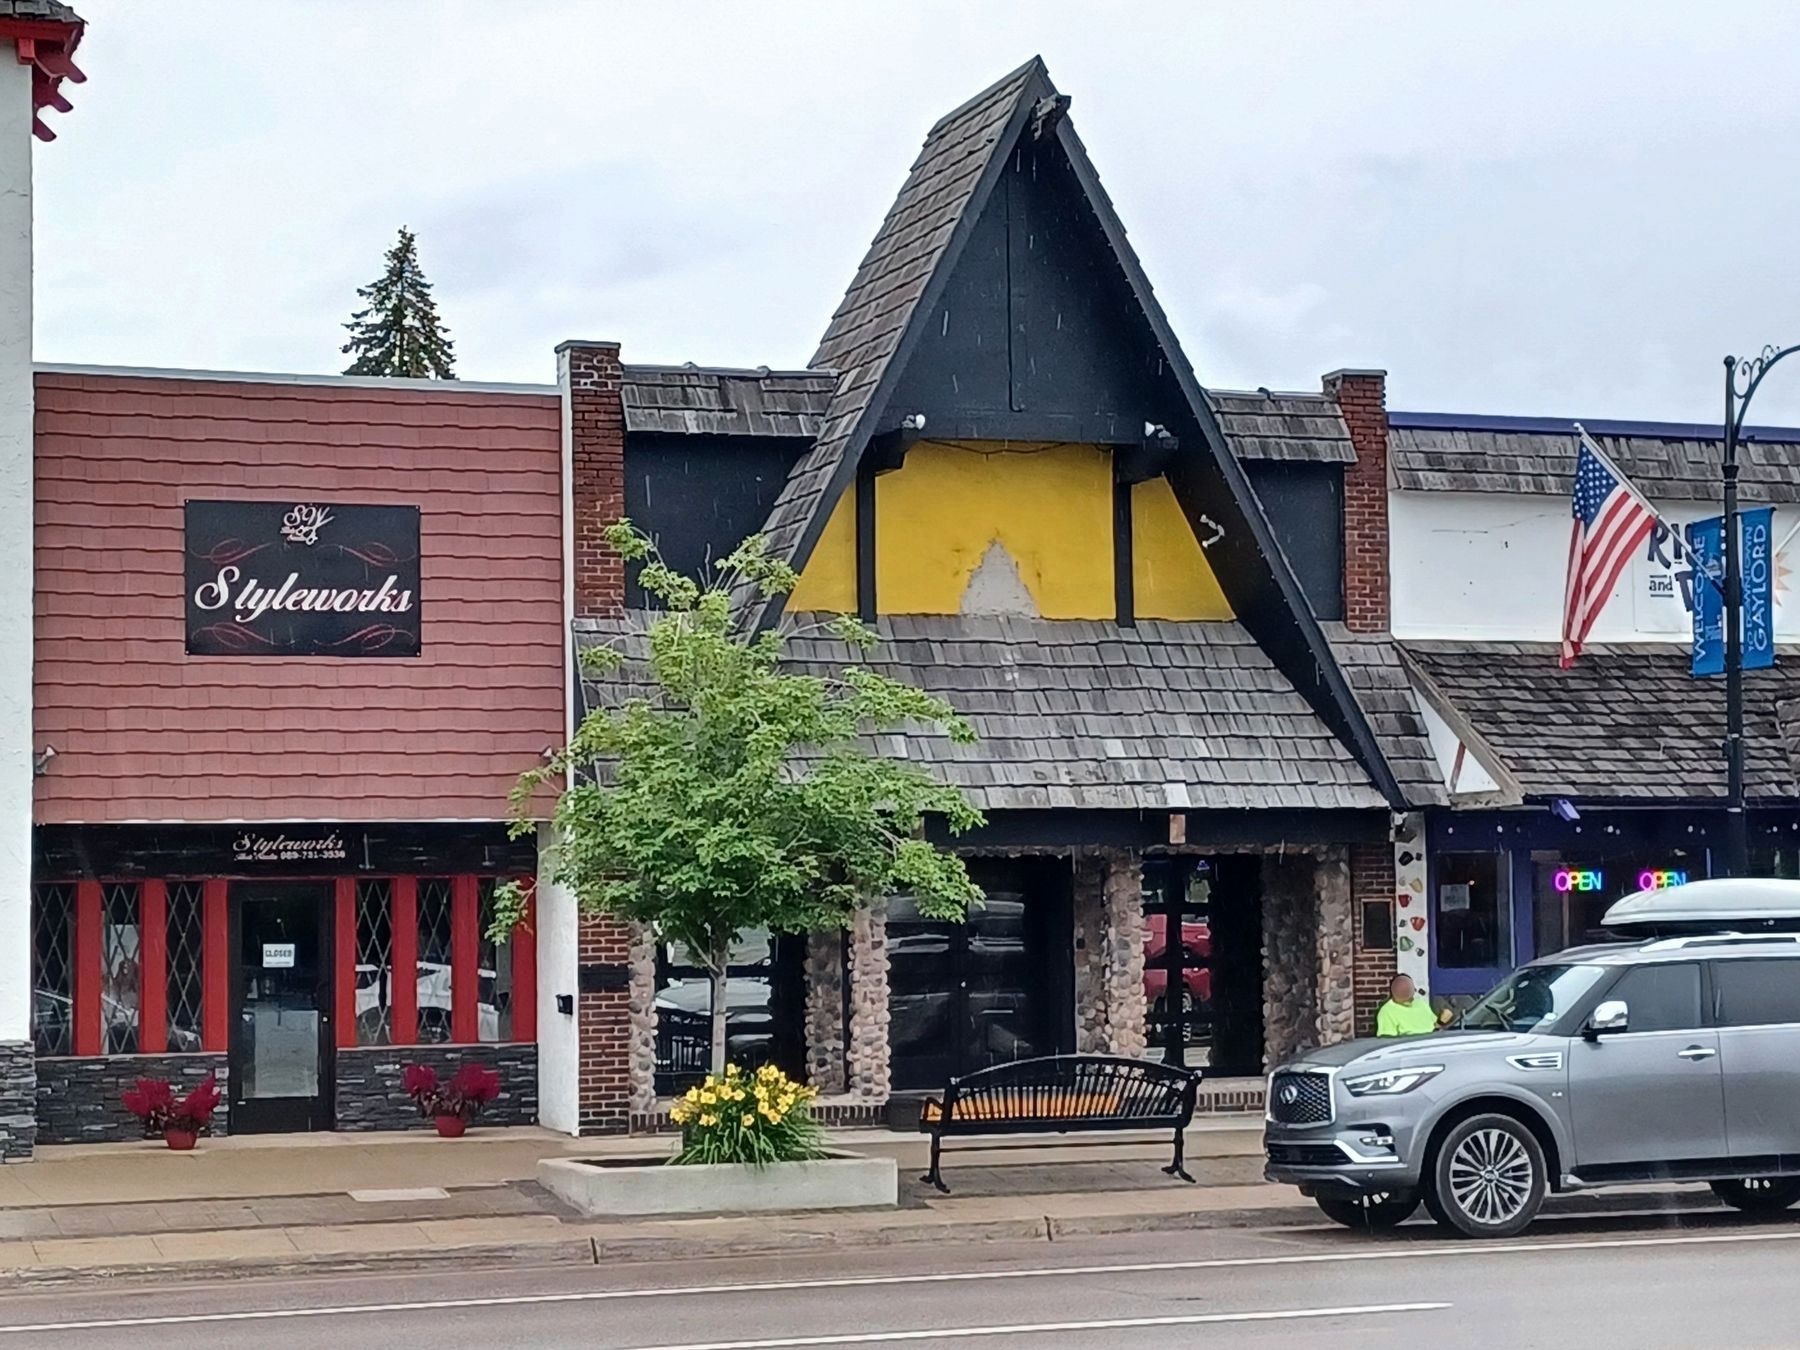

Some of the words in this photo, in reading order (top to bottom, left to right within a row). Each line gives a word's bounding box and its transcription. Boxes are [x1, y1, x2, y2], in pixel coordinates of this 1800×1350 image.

[194, 565, 412, 623] Styleworks
[1649, 575, 1673, 592] and
[1750, 524, 1768, 652] GAYLORD
[1693, 535, 1706, 661] WELCOME
[232, 833, 344, 855] Styleworks
[1554, 871, 1602, 891] OPEN
[1639, 871, 1687, 891] OPEN
